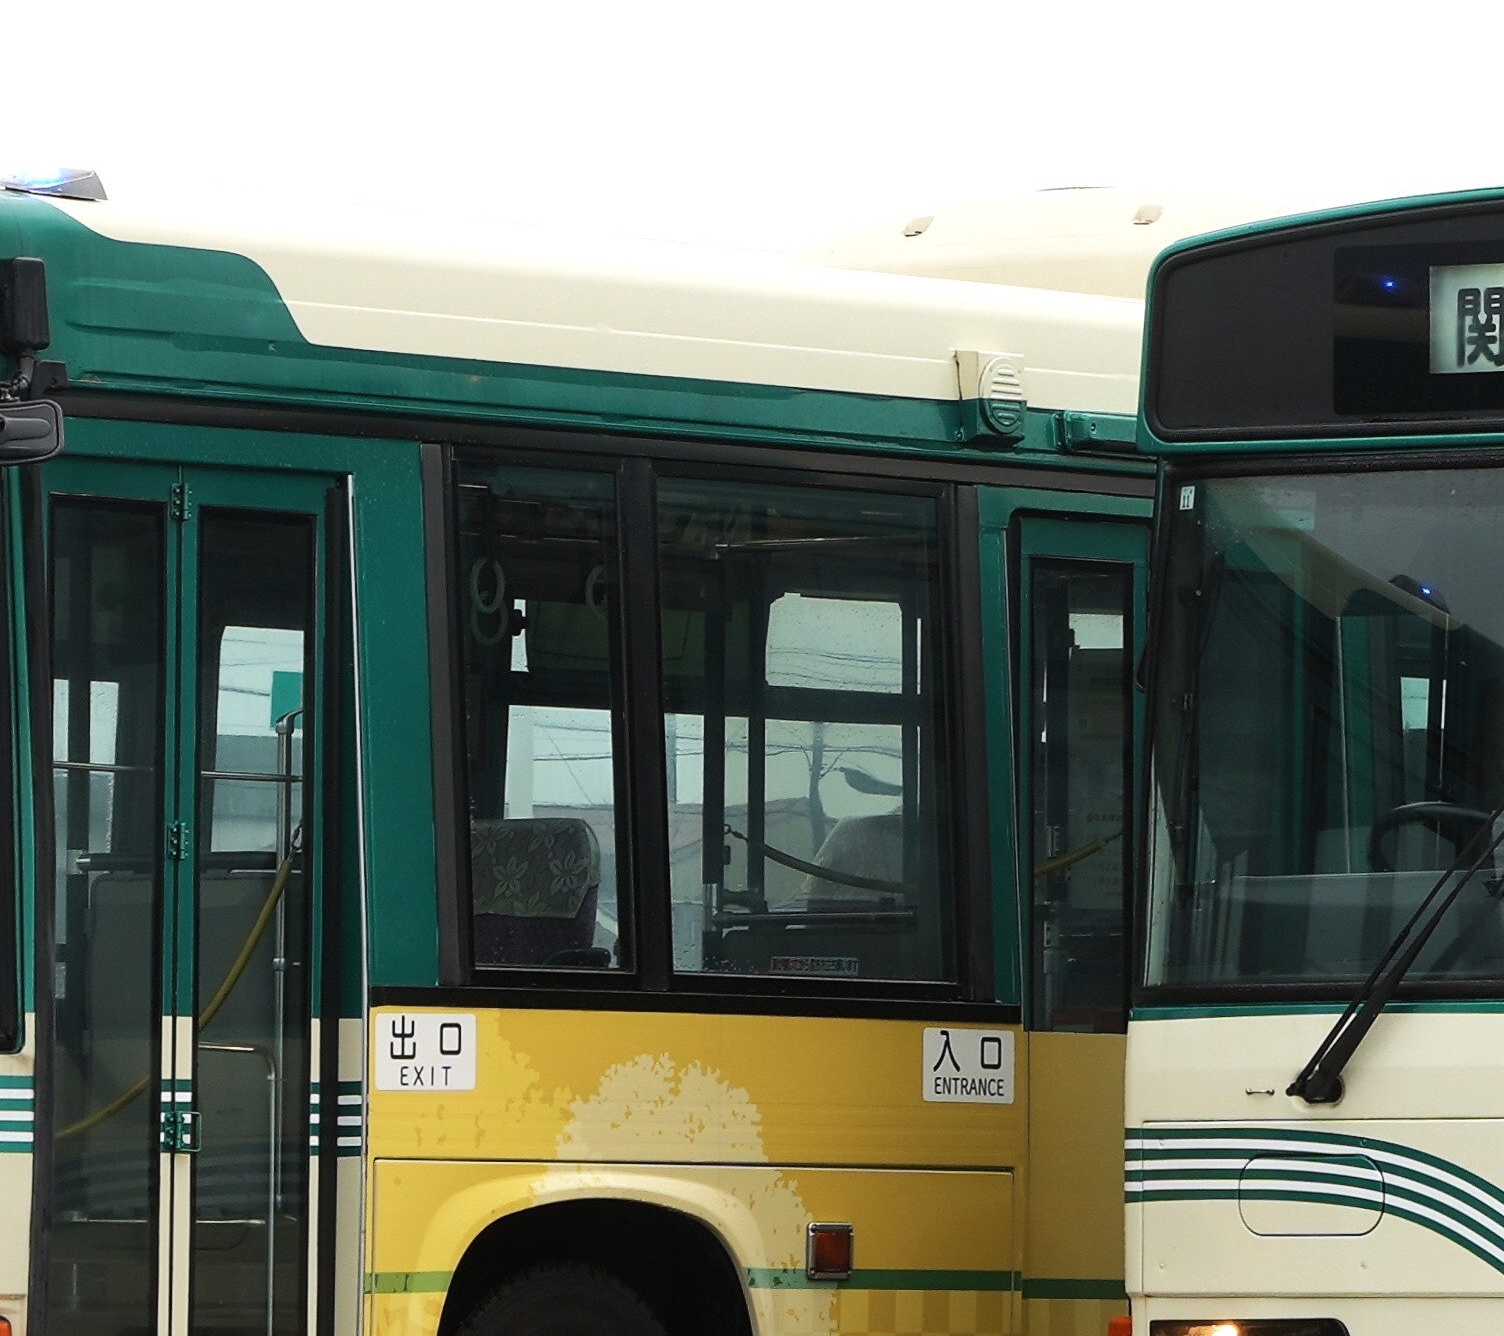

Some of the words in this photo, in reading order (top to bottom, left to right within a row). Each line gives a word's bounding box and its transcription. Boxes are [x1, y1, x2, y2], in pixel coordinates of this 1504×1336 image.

[390, 1015, 462, 1060] 出口
[933, 1030, 1002, 1072] 入口
[400, 1066, 452, 1086] EXIT
[934, 1076, 1005, 1097] ENTRANCE
